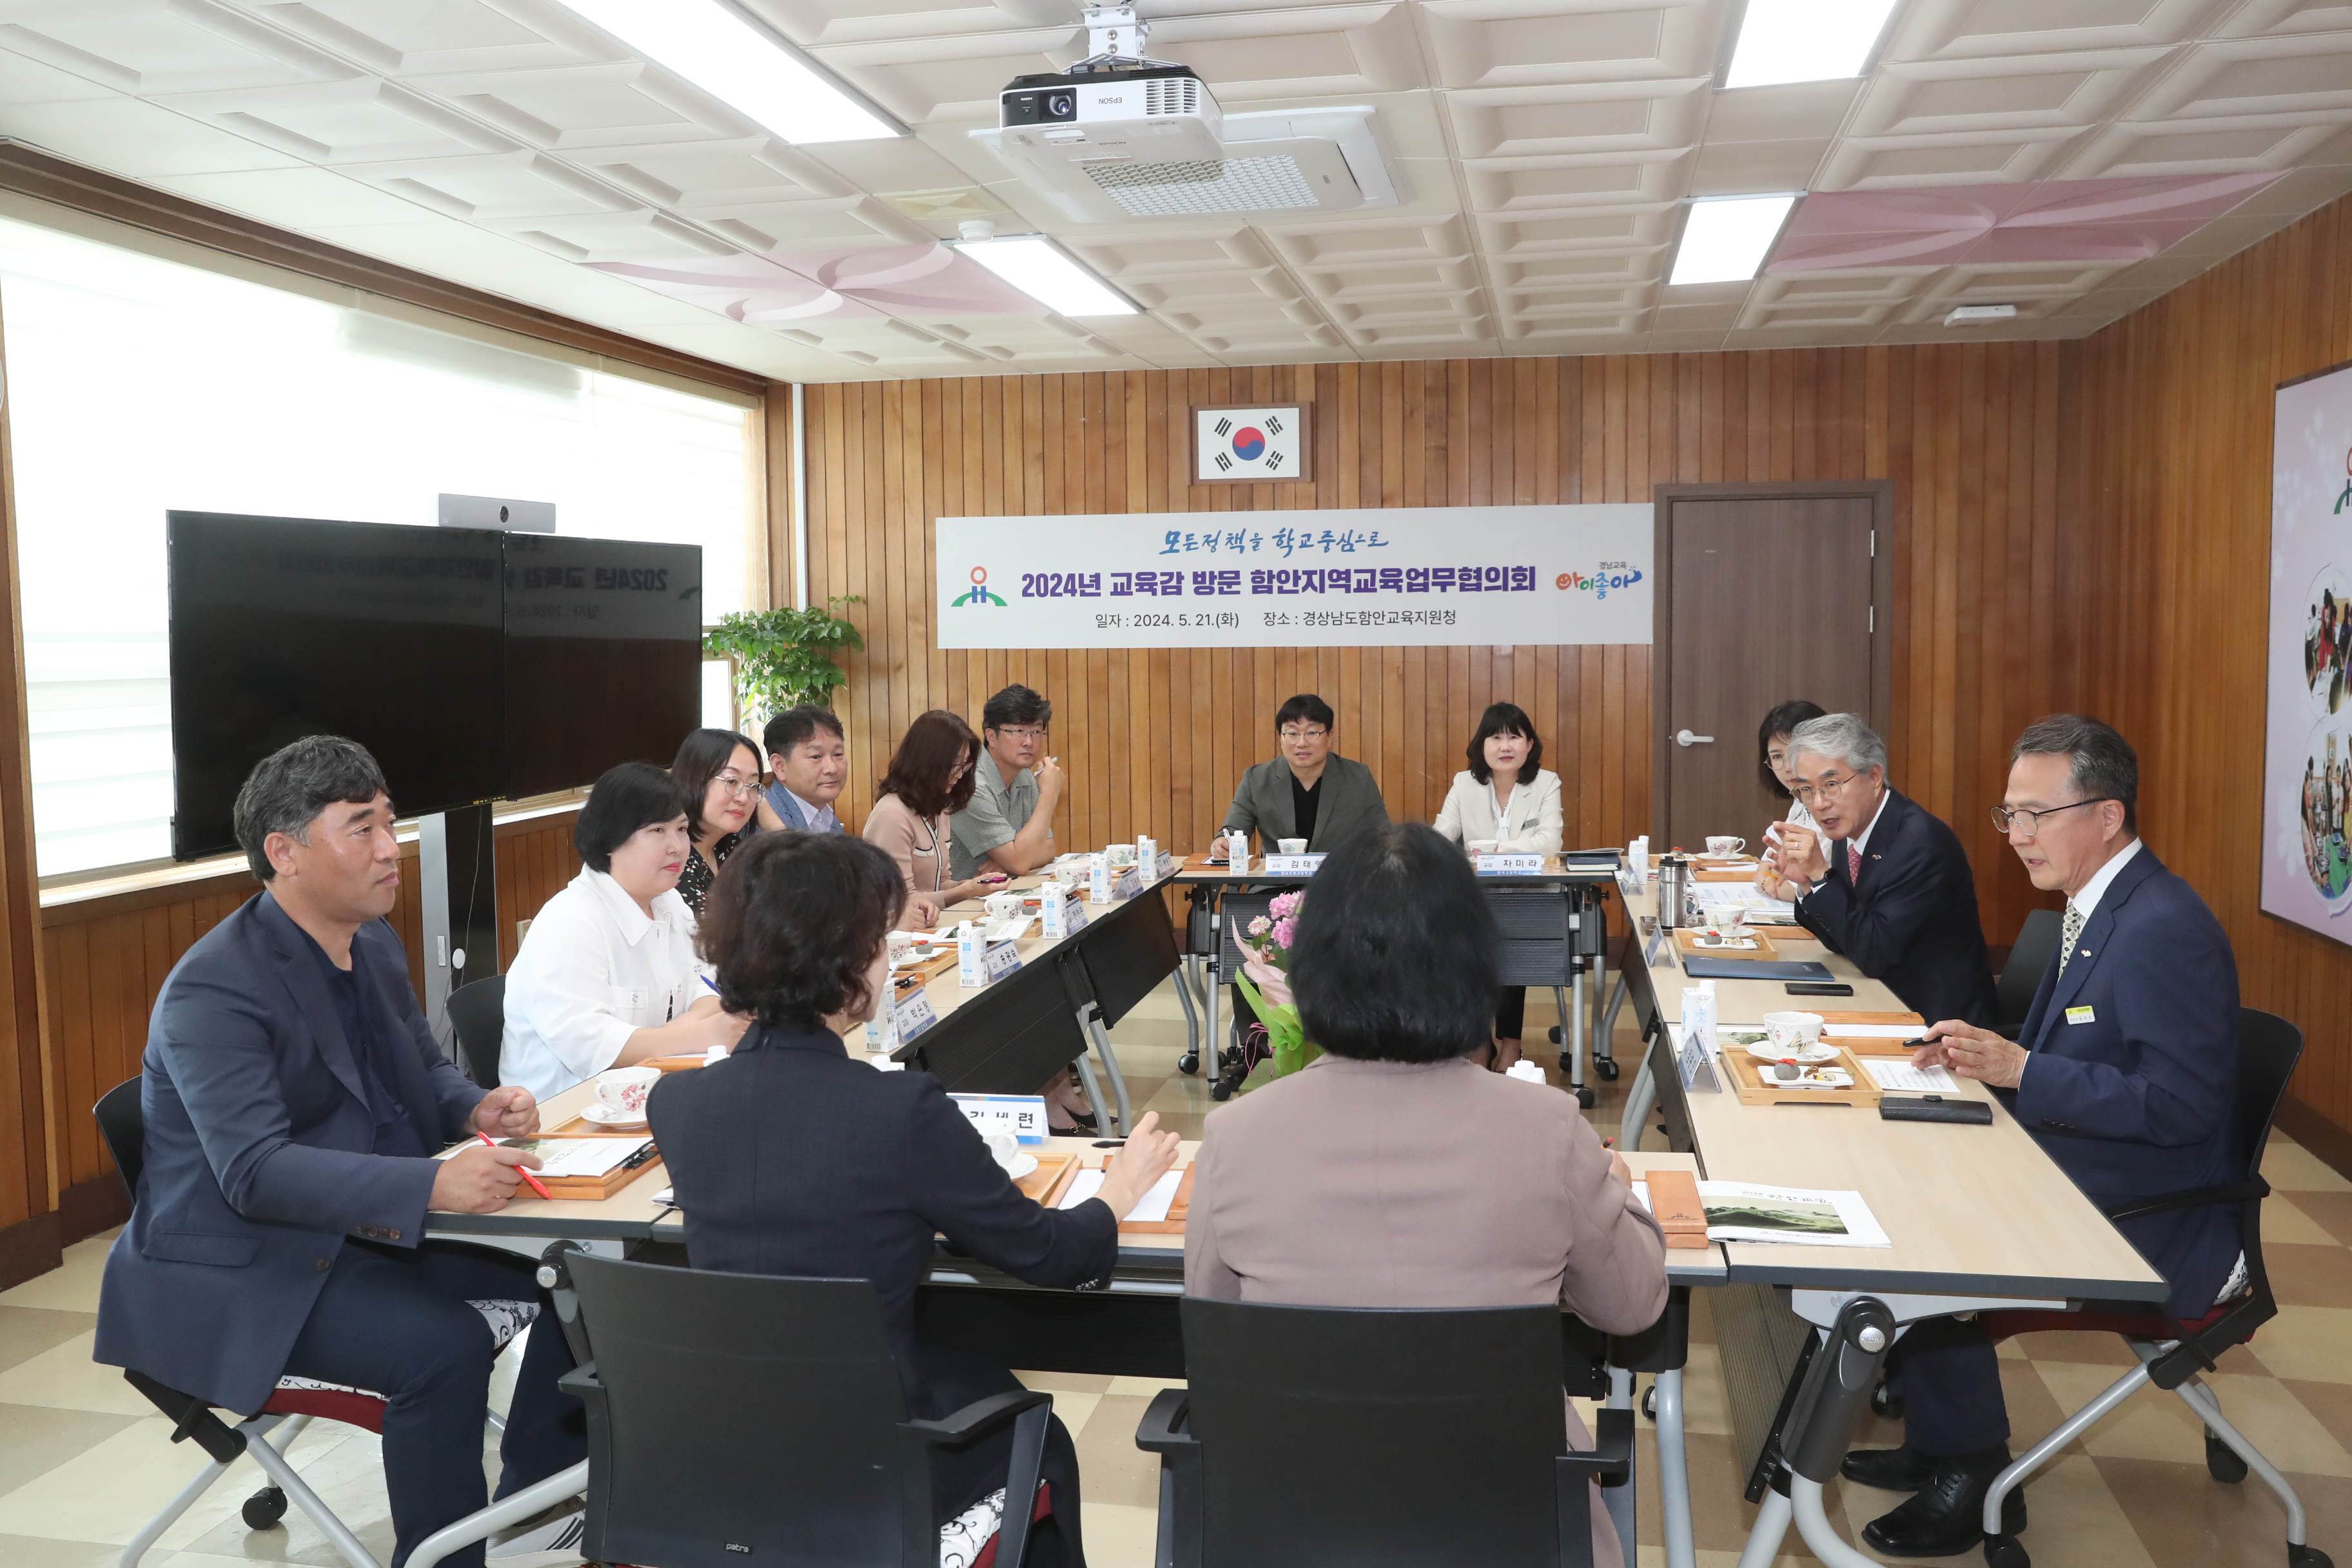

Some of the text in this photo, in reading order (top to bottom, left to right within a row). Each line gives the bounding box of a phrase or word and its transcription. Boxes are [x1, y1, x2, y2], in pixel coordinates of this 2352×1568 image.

[1599, 562, 1627, 570] 경남교육
[1021, 565, 1536, 598] 2024년 교육감 방문 함안지역교육업무협의회
[1556, 569, 1642, 600] 아이좋아
[1095, 613, 1122, 629] 일자
[1133, 614, 1174, 627] 2024.
[1179, 614, 1191, 627] 5.
[1195, 612, 1239, 629] 21.(화)
[1263, 611, 1291, 627] 장소
[1302, 609, 1456, 626] 경상남도함안교육지원청
[1503, 859, 1538, 868] 차미라
[726, 1543, 749, 1553] patra
